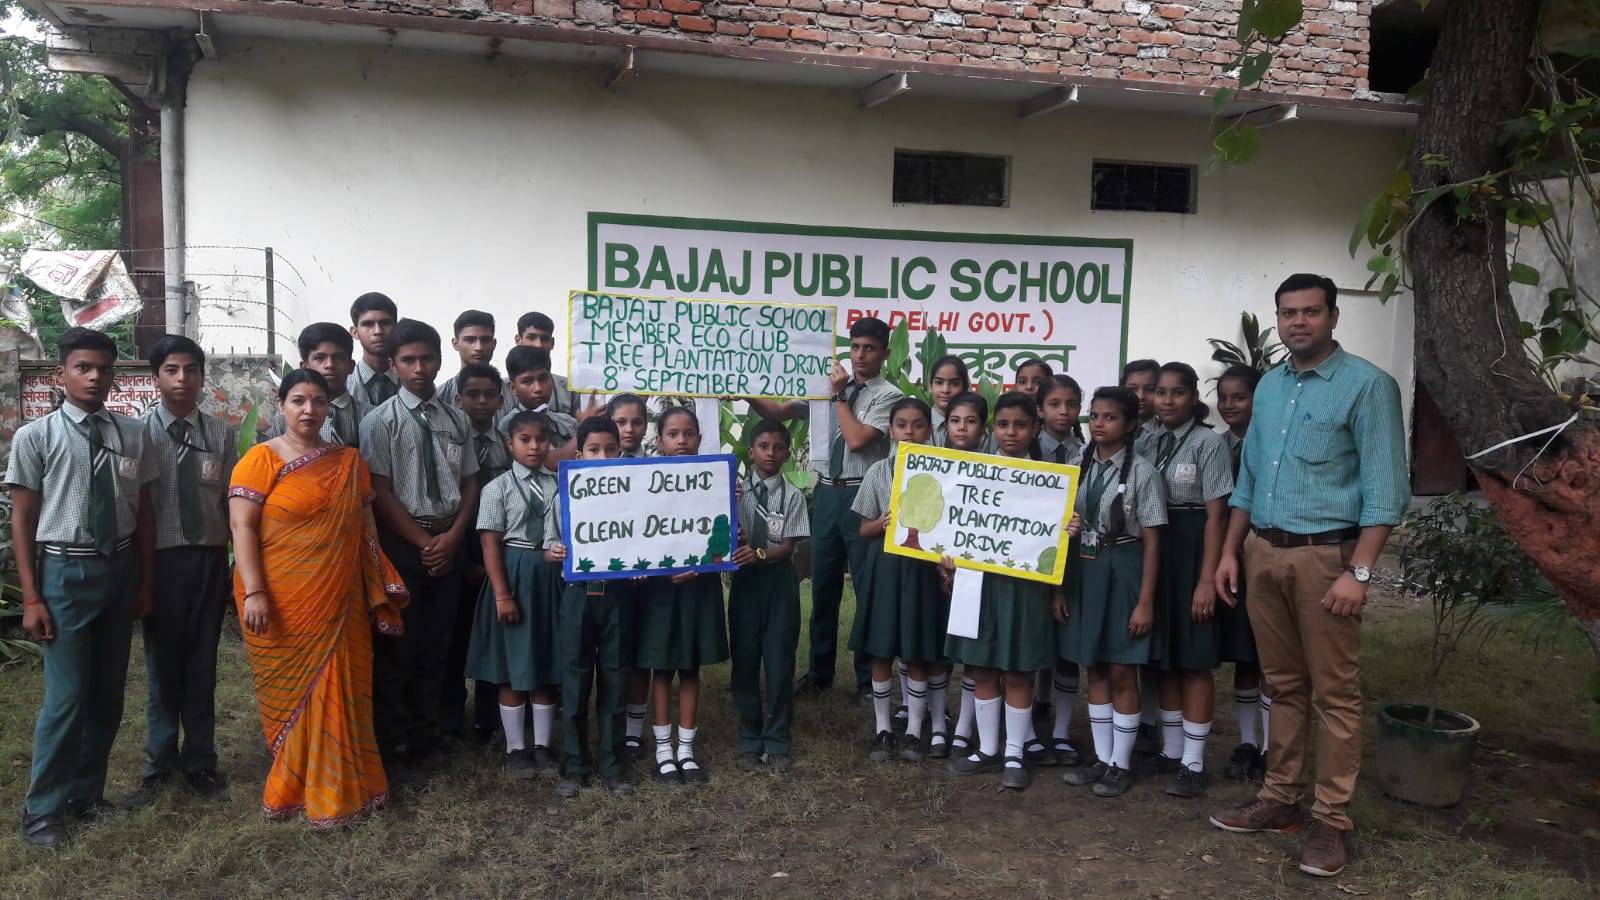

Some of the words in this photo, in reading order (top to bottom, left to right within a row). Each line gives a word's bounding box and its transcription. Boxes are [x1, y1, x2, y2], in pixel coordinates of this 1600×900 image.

[604, 242, 752, 296] BAJAJ
[763, 250, 938, 301] PUBLIC
[949, 258, 1122, 305] SCHOOL
[583, 293, 667, 323] BAJAJ
[675, 301, 753, 328] PUBLIC
[756, 304, 833, 333] SCHOOL
[889, 310, 960, 331] DELHI
[591, 320, 682, 345] MEMBER
[691, 324, 731, 349] ECO
[739, 329, 789, 353] CLUB
[580, 341, 645, 368] TREE
[653, 347, 774, 375] PLANTATION
[783, 353, 833, 377] DRIVE
[633, 368, 749, 395] SEPTEMBER
[759, 375, 807, 397] 2018
[569, 473, 631, 500] GREEN
[648, 470, 714, 494] DELHI
[906, 453, 955, 474] BAJAJ
[957, 461, 1008, 482] PUBLIC
[1009, 469, 1065, 490] SCHOOL
[956, 483, 1004, 507] TREE
[574, 519, 635, 545] CLEAN
[642, 514, 712, 538] DELHI
[948, 505, 1057, 538] PLANTATION
[953, 530, 1013, 557] DRIVE
